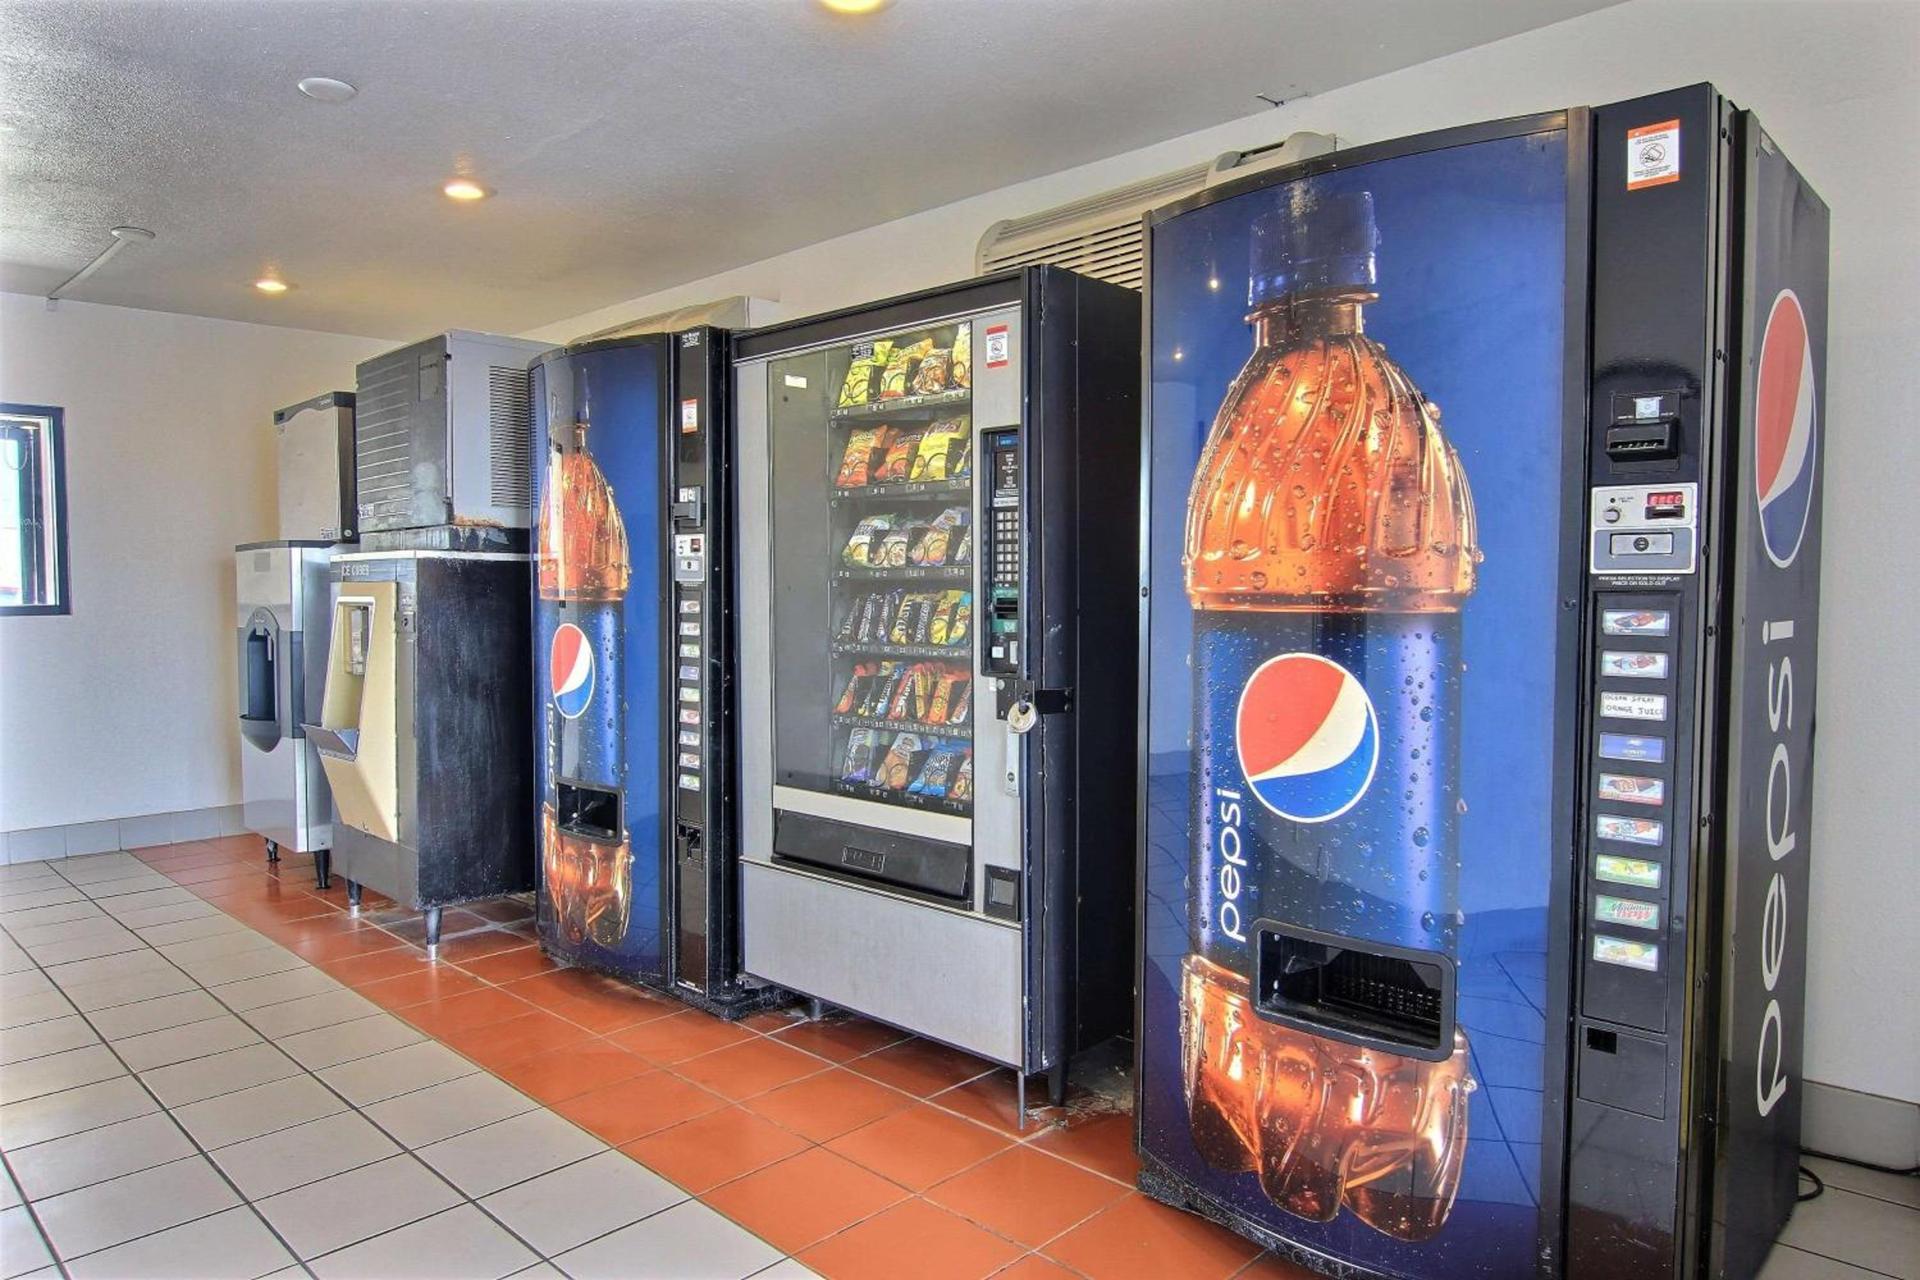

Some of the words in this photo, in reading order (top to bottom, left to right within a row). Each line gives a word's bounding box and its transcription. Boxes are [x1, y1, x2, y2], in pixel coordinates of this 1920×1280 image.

[546, 702, 556, 790] pepsi
[1217, 787, 1248, 943] pepsi
[1757, 619, 1796, 1117] pepsi
